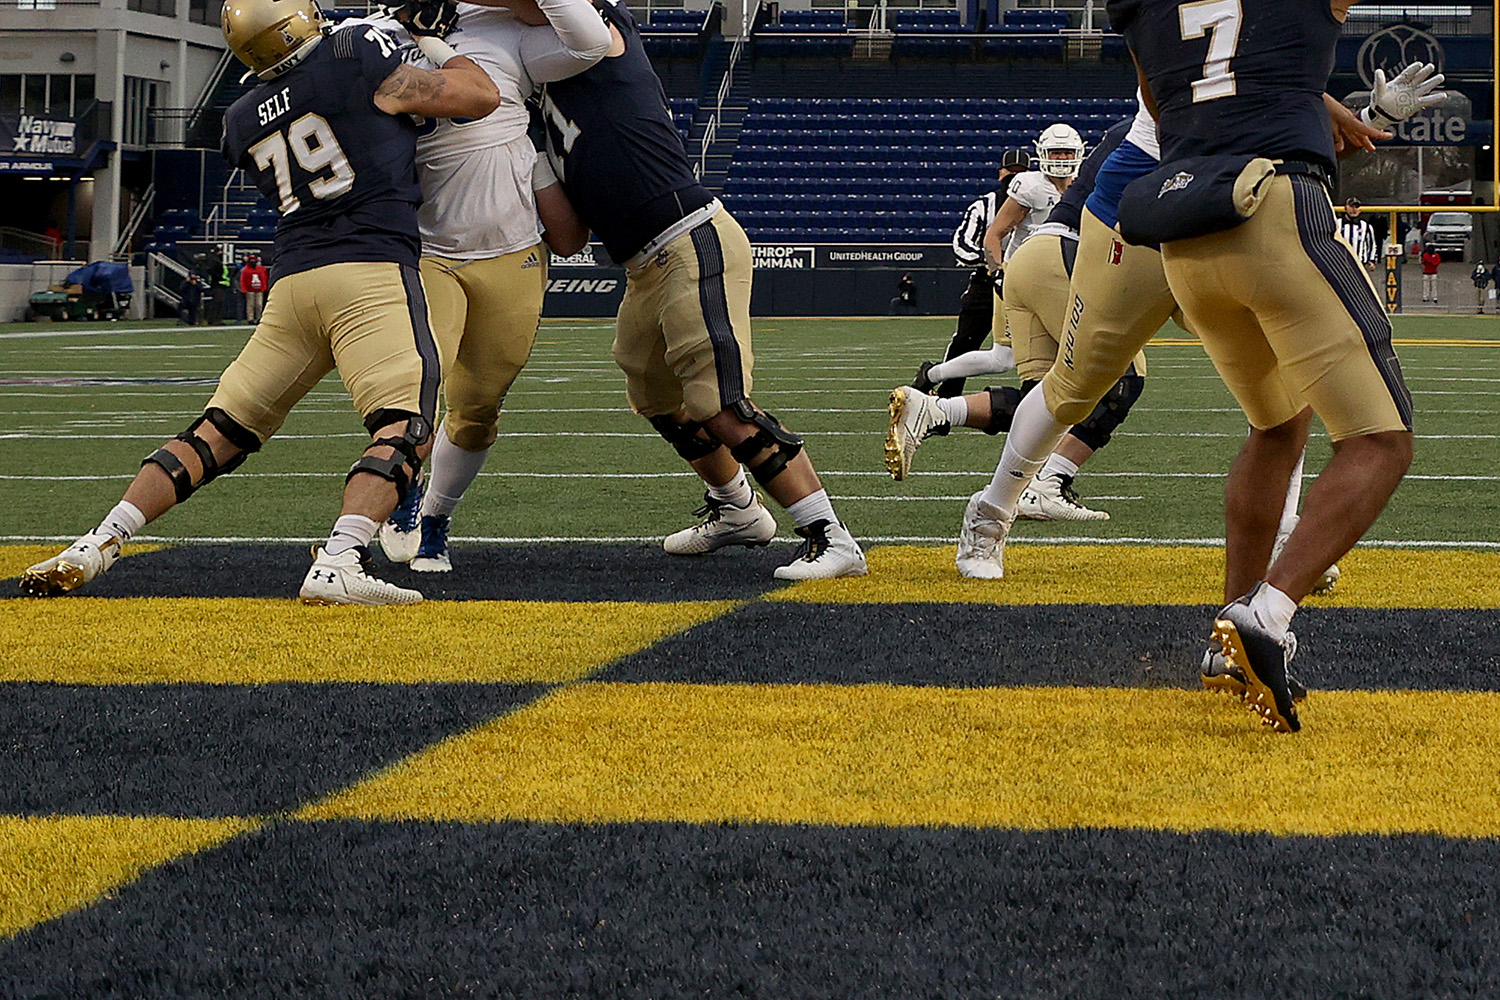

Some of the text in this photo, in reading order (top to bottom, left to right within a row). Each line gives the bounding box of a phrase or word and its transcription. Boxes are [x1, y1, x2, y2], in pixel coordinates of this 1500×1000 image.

[271, 54, 301, 76] NAVY
[257, 86, 291, 127] SELF
[248, 111, 356, 217] 79
[550, 253, 596, 264] FEDERAL
[1386, 255, 1398, 314] NAVY
